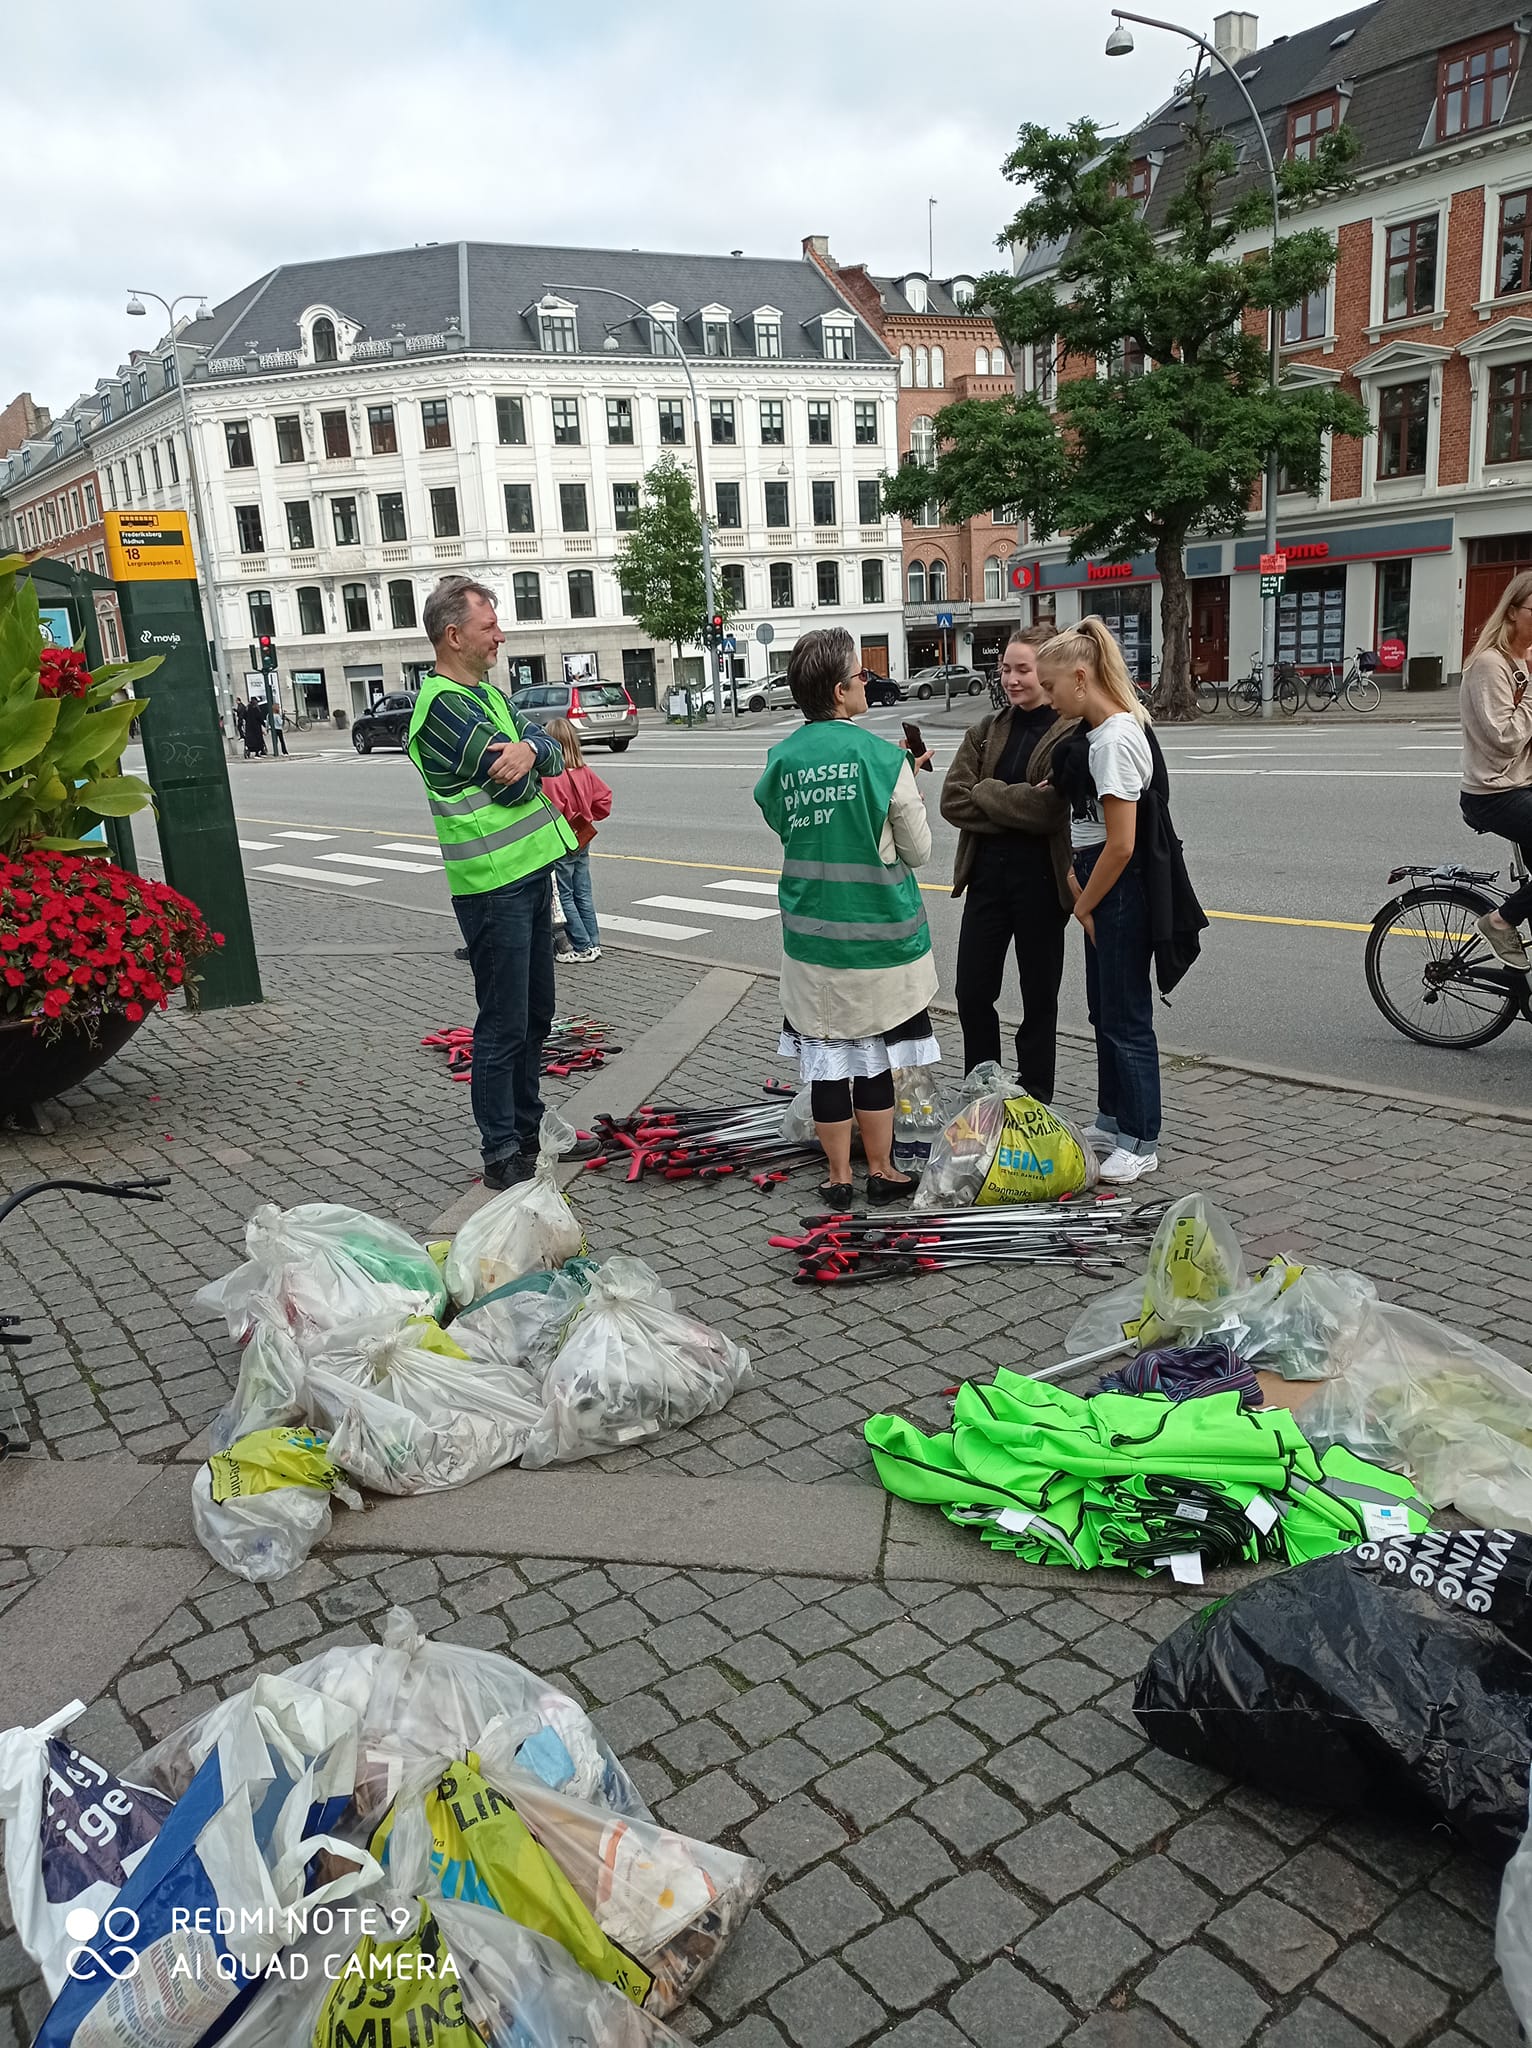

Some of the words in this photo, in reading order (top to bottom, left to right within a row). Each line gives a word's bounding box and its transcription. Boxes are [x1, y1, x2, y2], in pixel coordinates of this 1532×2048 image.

[125, 548, 141, 560] 18
[1087, 561, 1133, 580] home
[780, 773, 795, 790] VI
[797, 762, 859, 785] PASSER
[784, 789, 799, 811] PÅ
[800, 784, 857, 806] VORES
[814, 807, 836, 826] BY
[988, 1182, 1033, 1198] Danmarks
[1410, 1531, 1452, 1588] ING
[162, 1938, 190, 2010] FAIRRADE
